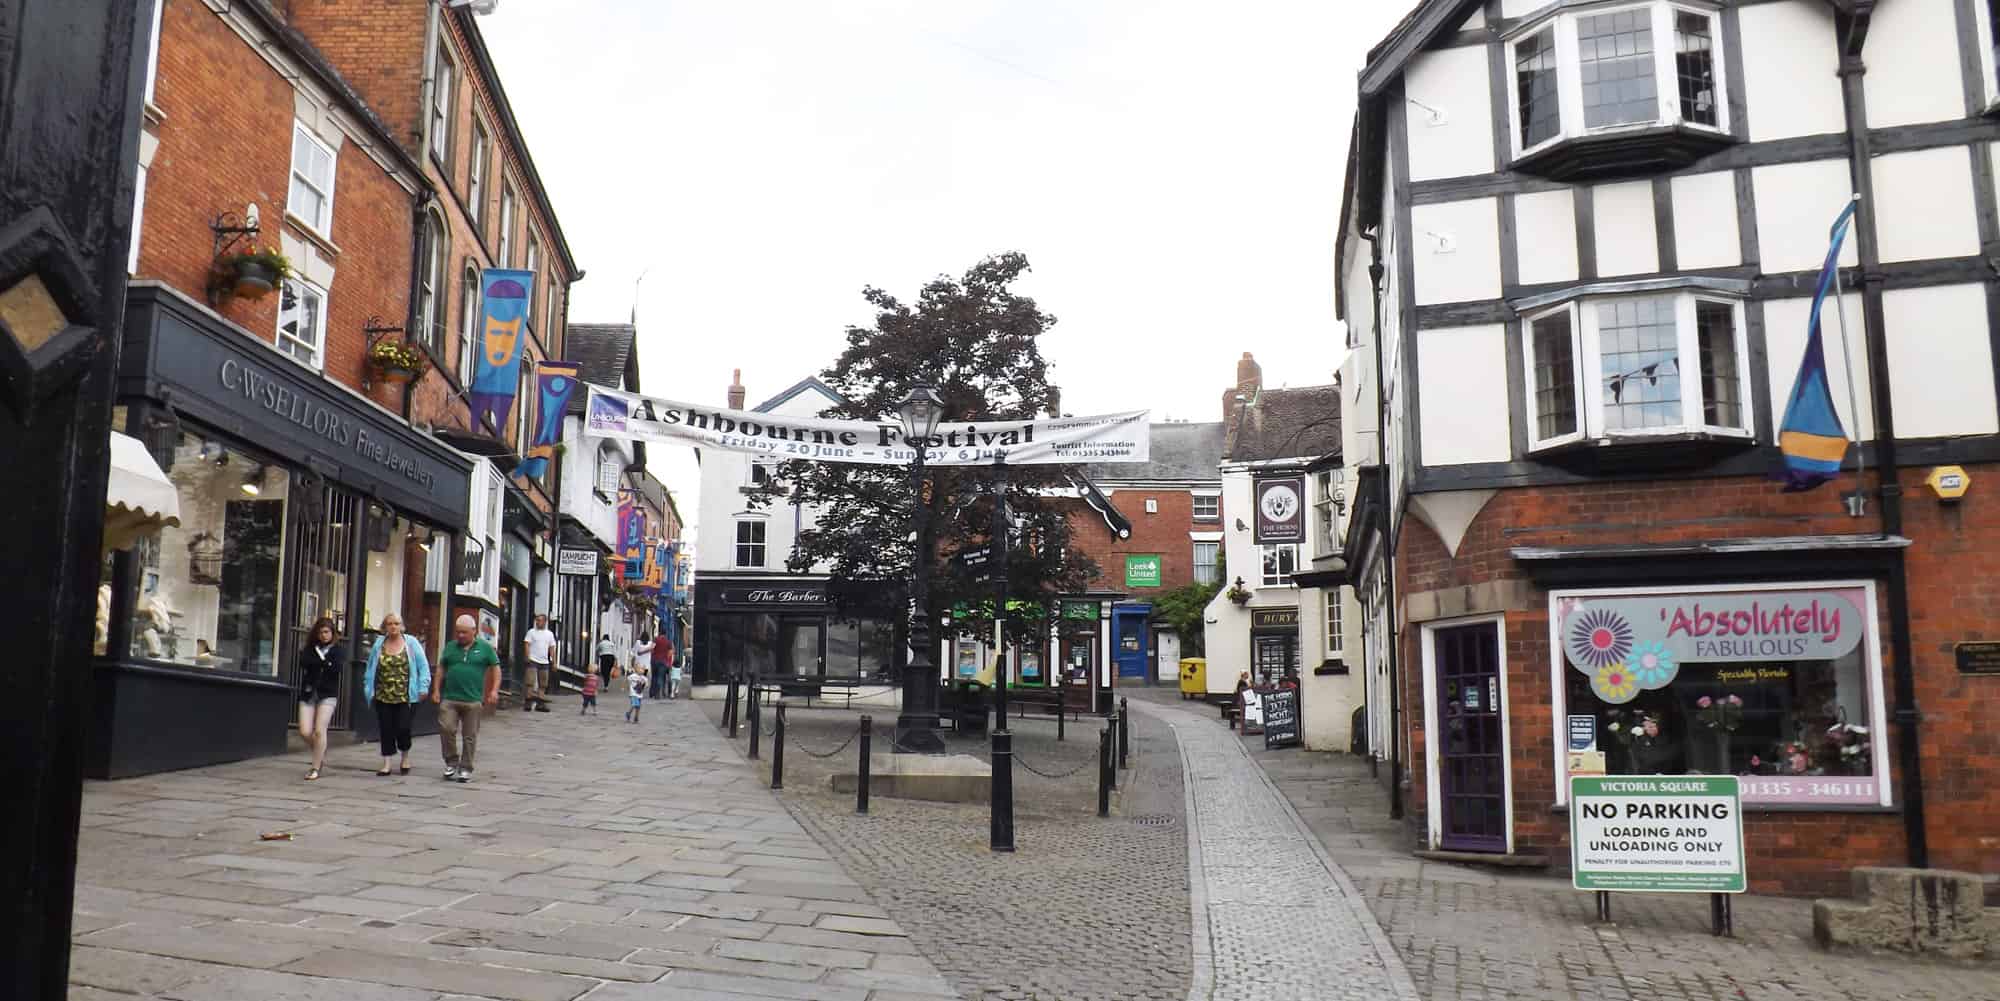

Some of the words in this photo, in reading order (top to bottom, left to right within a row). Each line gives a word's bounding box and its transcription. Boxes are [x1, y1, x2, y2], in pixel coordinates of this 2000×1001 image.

[631, 399, 858, 446] Ashbourne
[876, 424, 1034, 449] Festival
[356, 429, 382, 460] Fine
[721, 434, 779, 453] Friday
[785, 443, 810, 454] 20
[812, 443, 854, 458] June
[883, 449, 945, 462] Sunay
[958, 449, 969, 460] 6
[1051, 441, 1082, 449] Tourist
[1083, 441, 1136, 449] Information
[1129, 560, 1148, 569] Leek
[1129, 569, 1156, 577] United
[748, 590, 775, 602] The
[778, 590, 820, 602] Barber
[1263, 614, 1291, 623] BURY
[1600, 782, 1656, 792] VICTORIA
[1659, 782, 1709, 792] SQUARE
[1807, 782, 1873, 796] 346111
[1583, 803, 1618, 819] NO
[1626, 803, 1729, 820] PARKING
[1603, 827, 1670, 838] LOADING
[1675, 827, 1708, 838] AND
[1590, 841, 1679, 852] UNLOADING
[1684, 842, 1723, 853] ONLY
